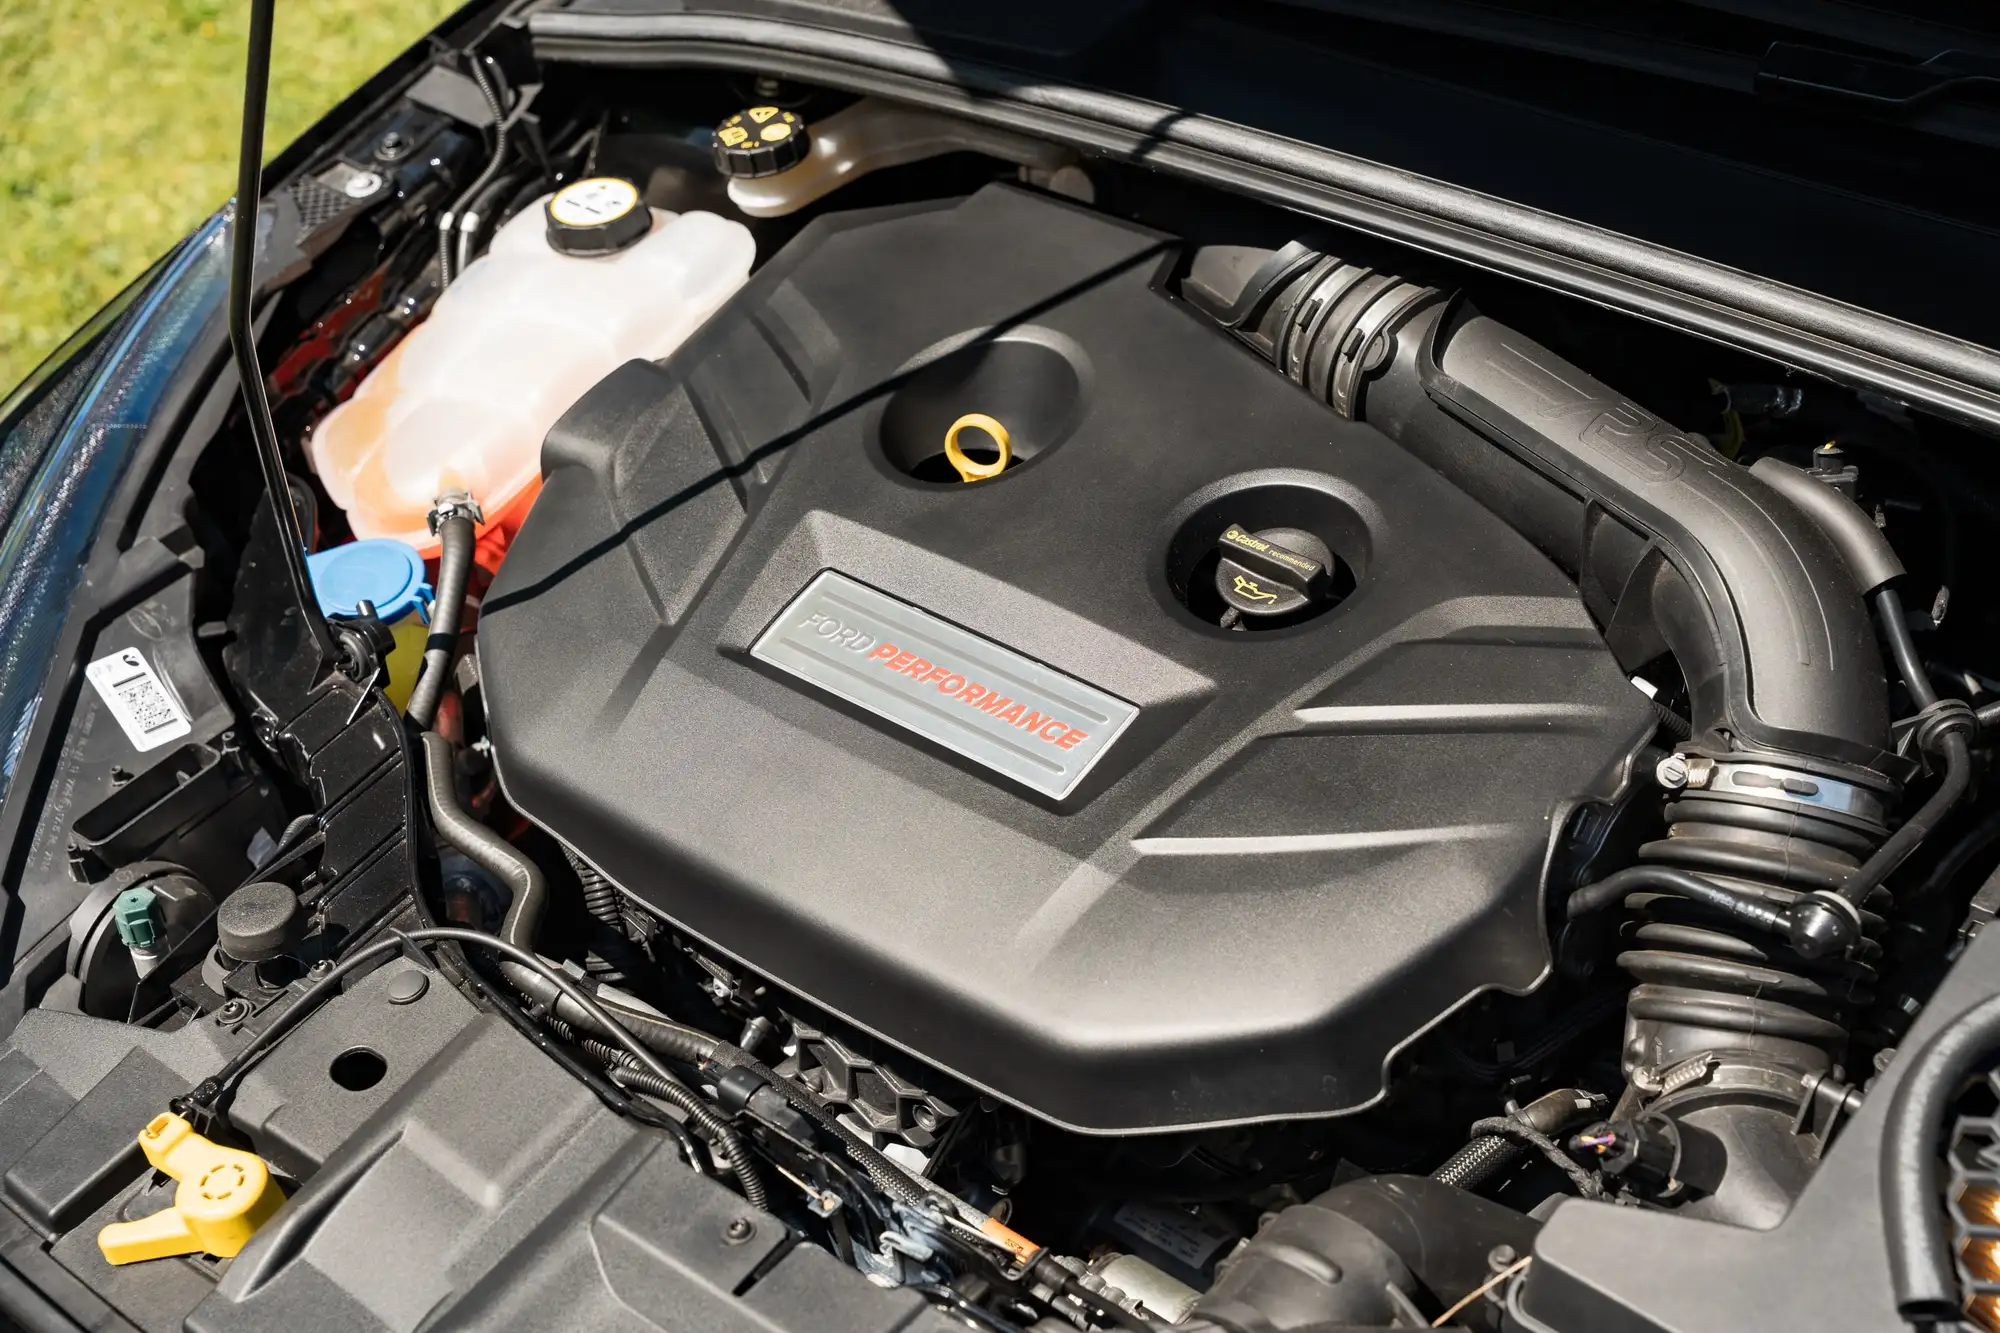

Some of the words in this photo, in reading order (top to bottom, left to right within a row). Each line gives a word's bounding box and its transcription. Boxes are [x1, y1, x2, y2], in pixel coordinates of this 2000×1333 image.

[1235, 534, 1270, 552] Castrol
[1269, 549, 1317, 572] recommended
[798, 612, 876, 653] FORD
[866, 641, 1089, 752] PERFORMANCE
